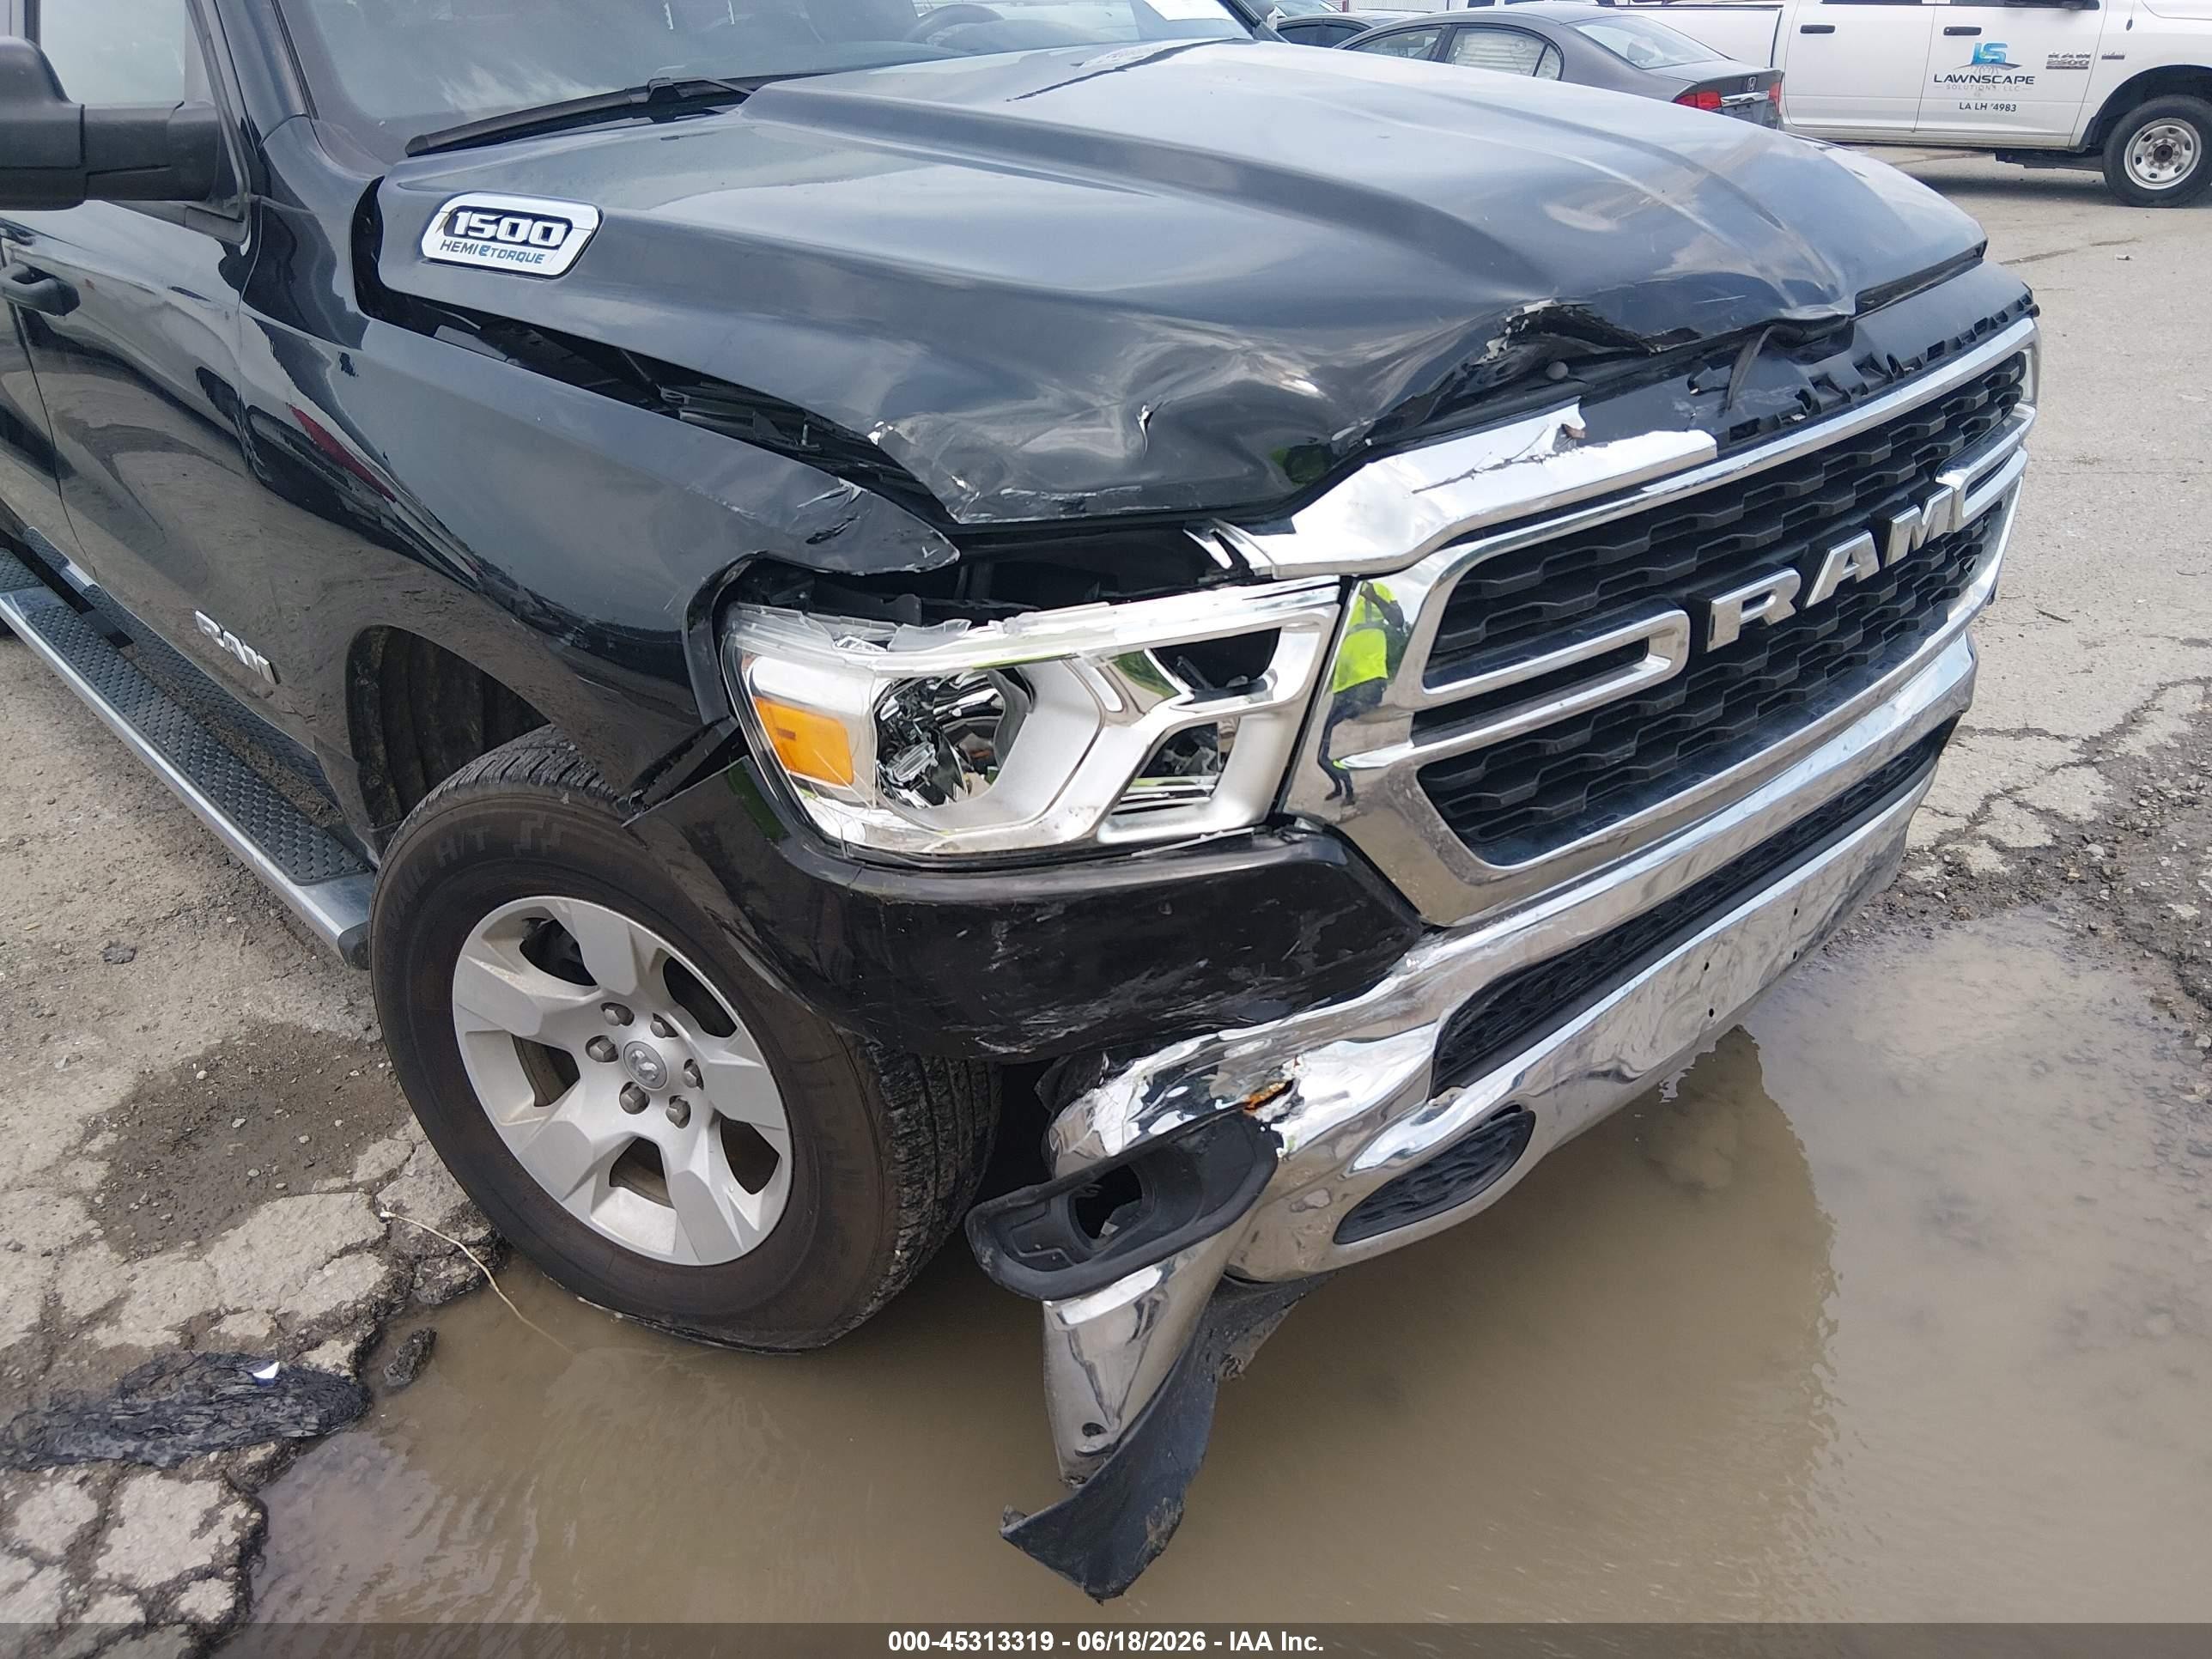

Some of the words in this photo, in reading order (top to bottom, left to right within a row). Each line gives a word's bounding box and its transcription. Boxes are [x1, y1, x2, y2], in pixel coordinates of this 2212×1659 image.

[1934, 74, 2035, 85] LAWNSCAPE
[440, 239, 479, 255] HEMI
[454, 210, 568, 247] 1500
[1706, 487, 1954, 653] RAM
[195, 610, 276, 685] RAM
